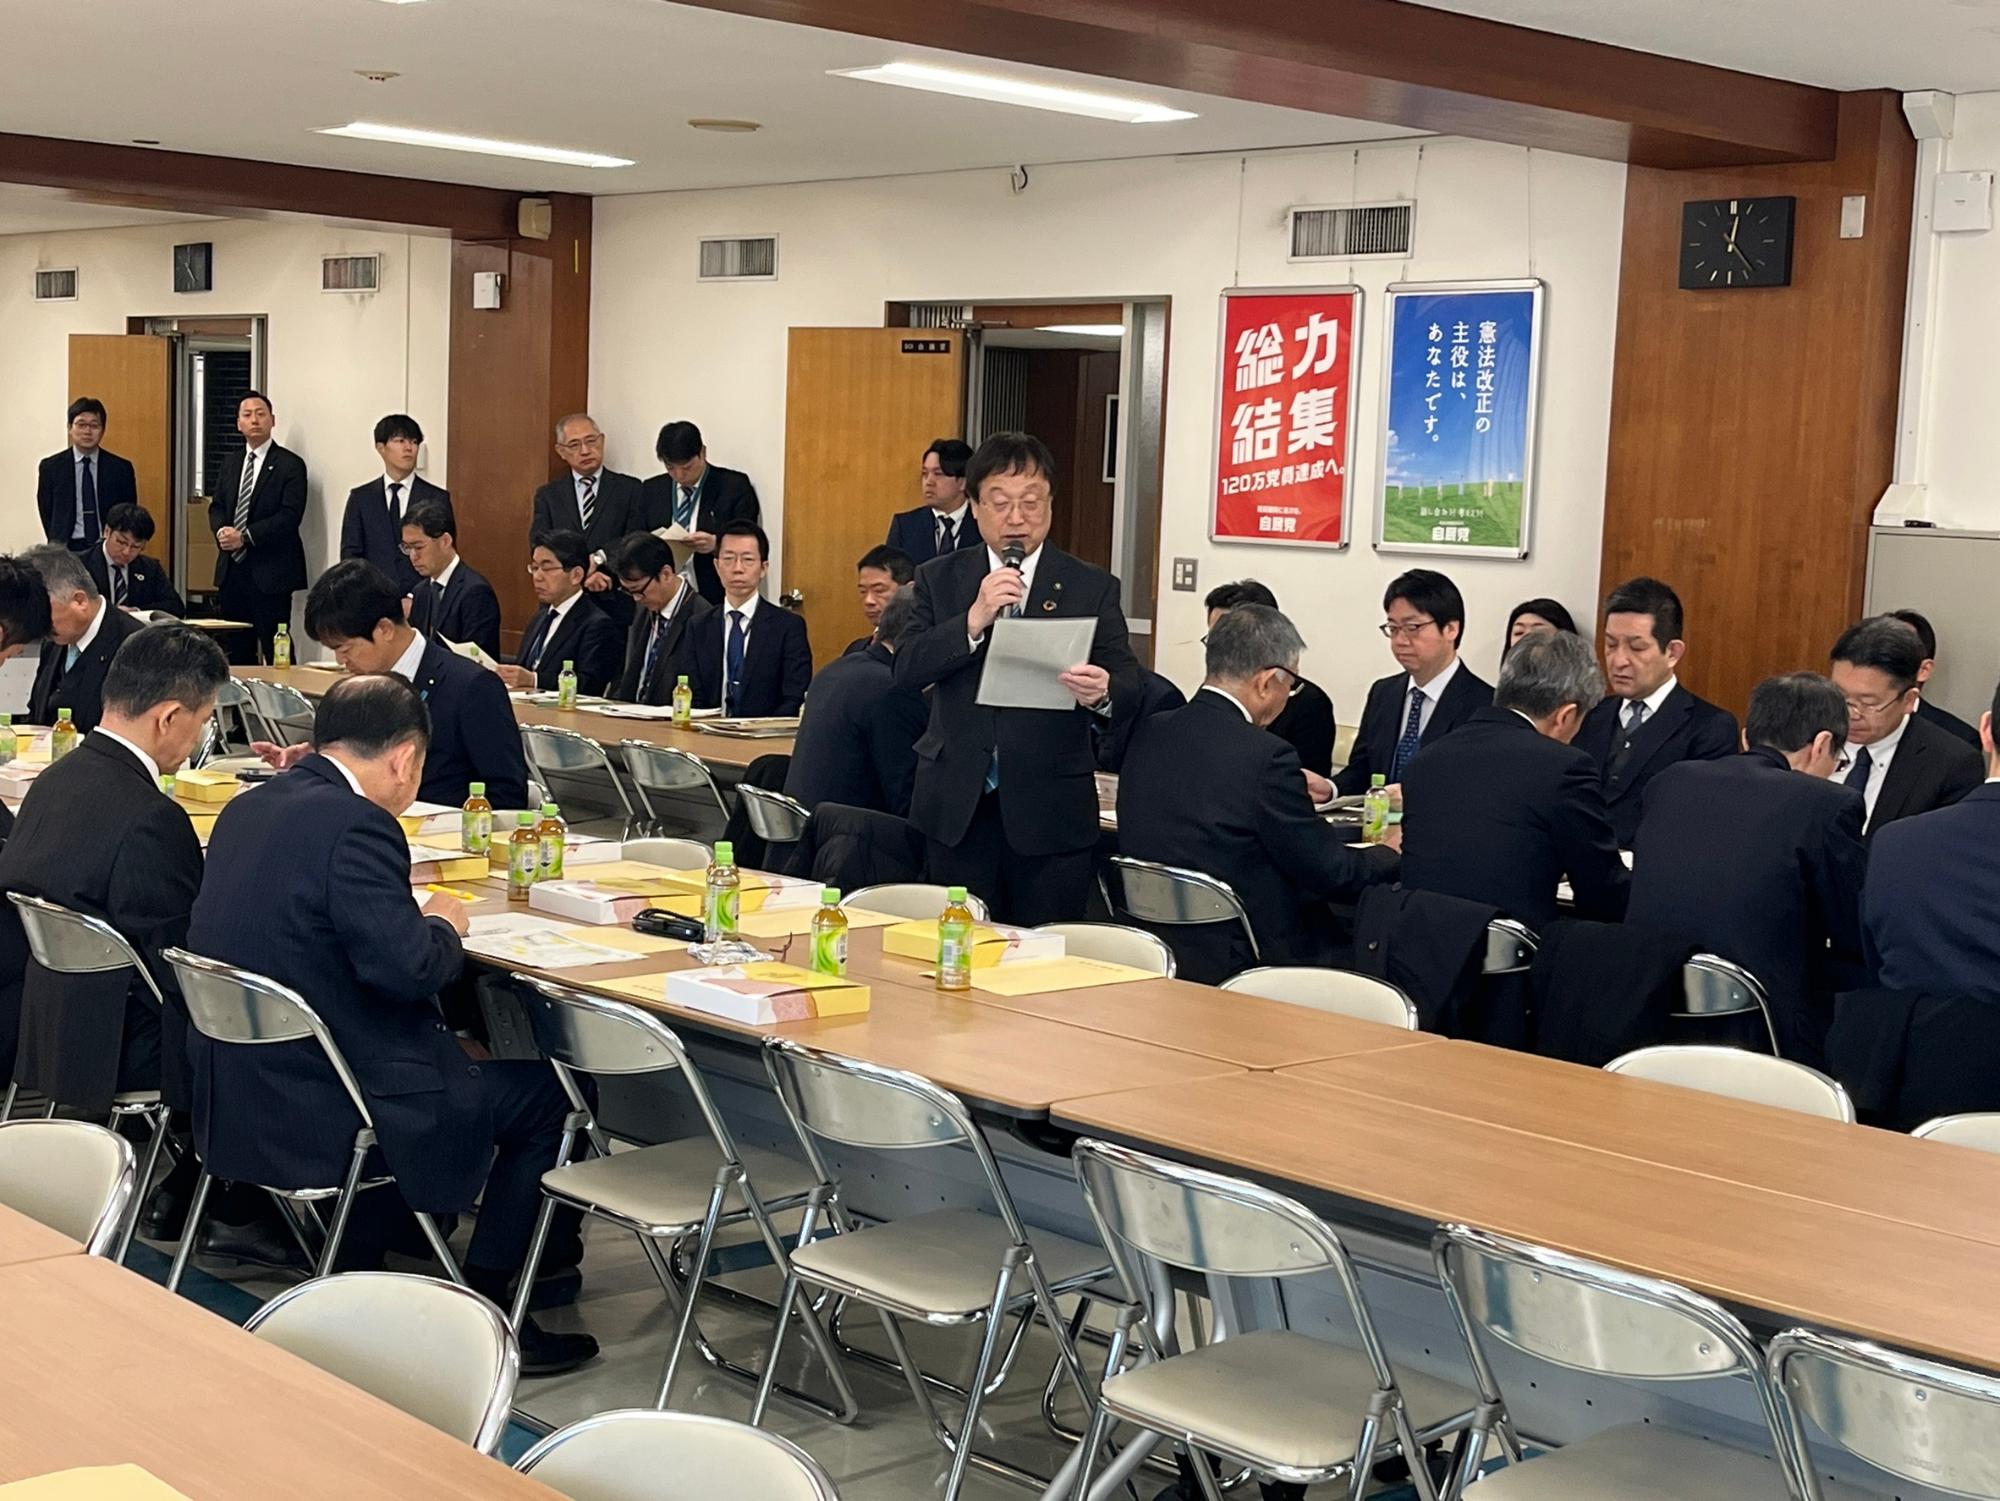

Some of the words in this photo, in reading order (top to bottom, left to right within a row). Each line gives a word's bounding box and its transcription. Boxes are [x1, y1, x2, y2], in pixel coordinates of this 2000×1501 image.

[1234, 312, 1339, 392] 総力
[1423, 322, 1444, 442] あなたです。
[1450, 321, 1470, 400] 主役は、
[1475, 321, 1497, 433] 憲法改正の
[1230, 386, 1339, 466] 結集
[1221, 458, 1345, 495] 120万党員達成へ。
